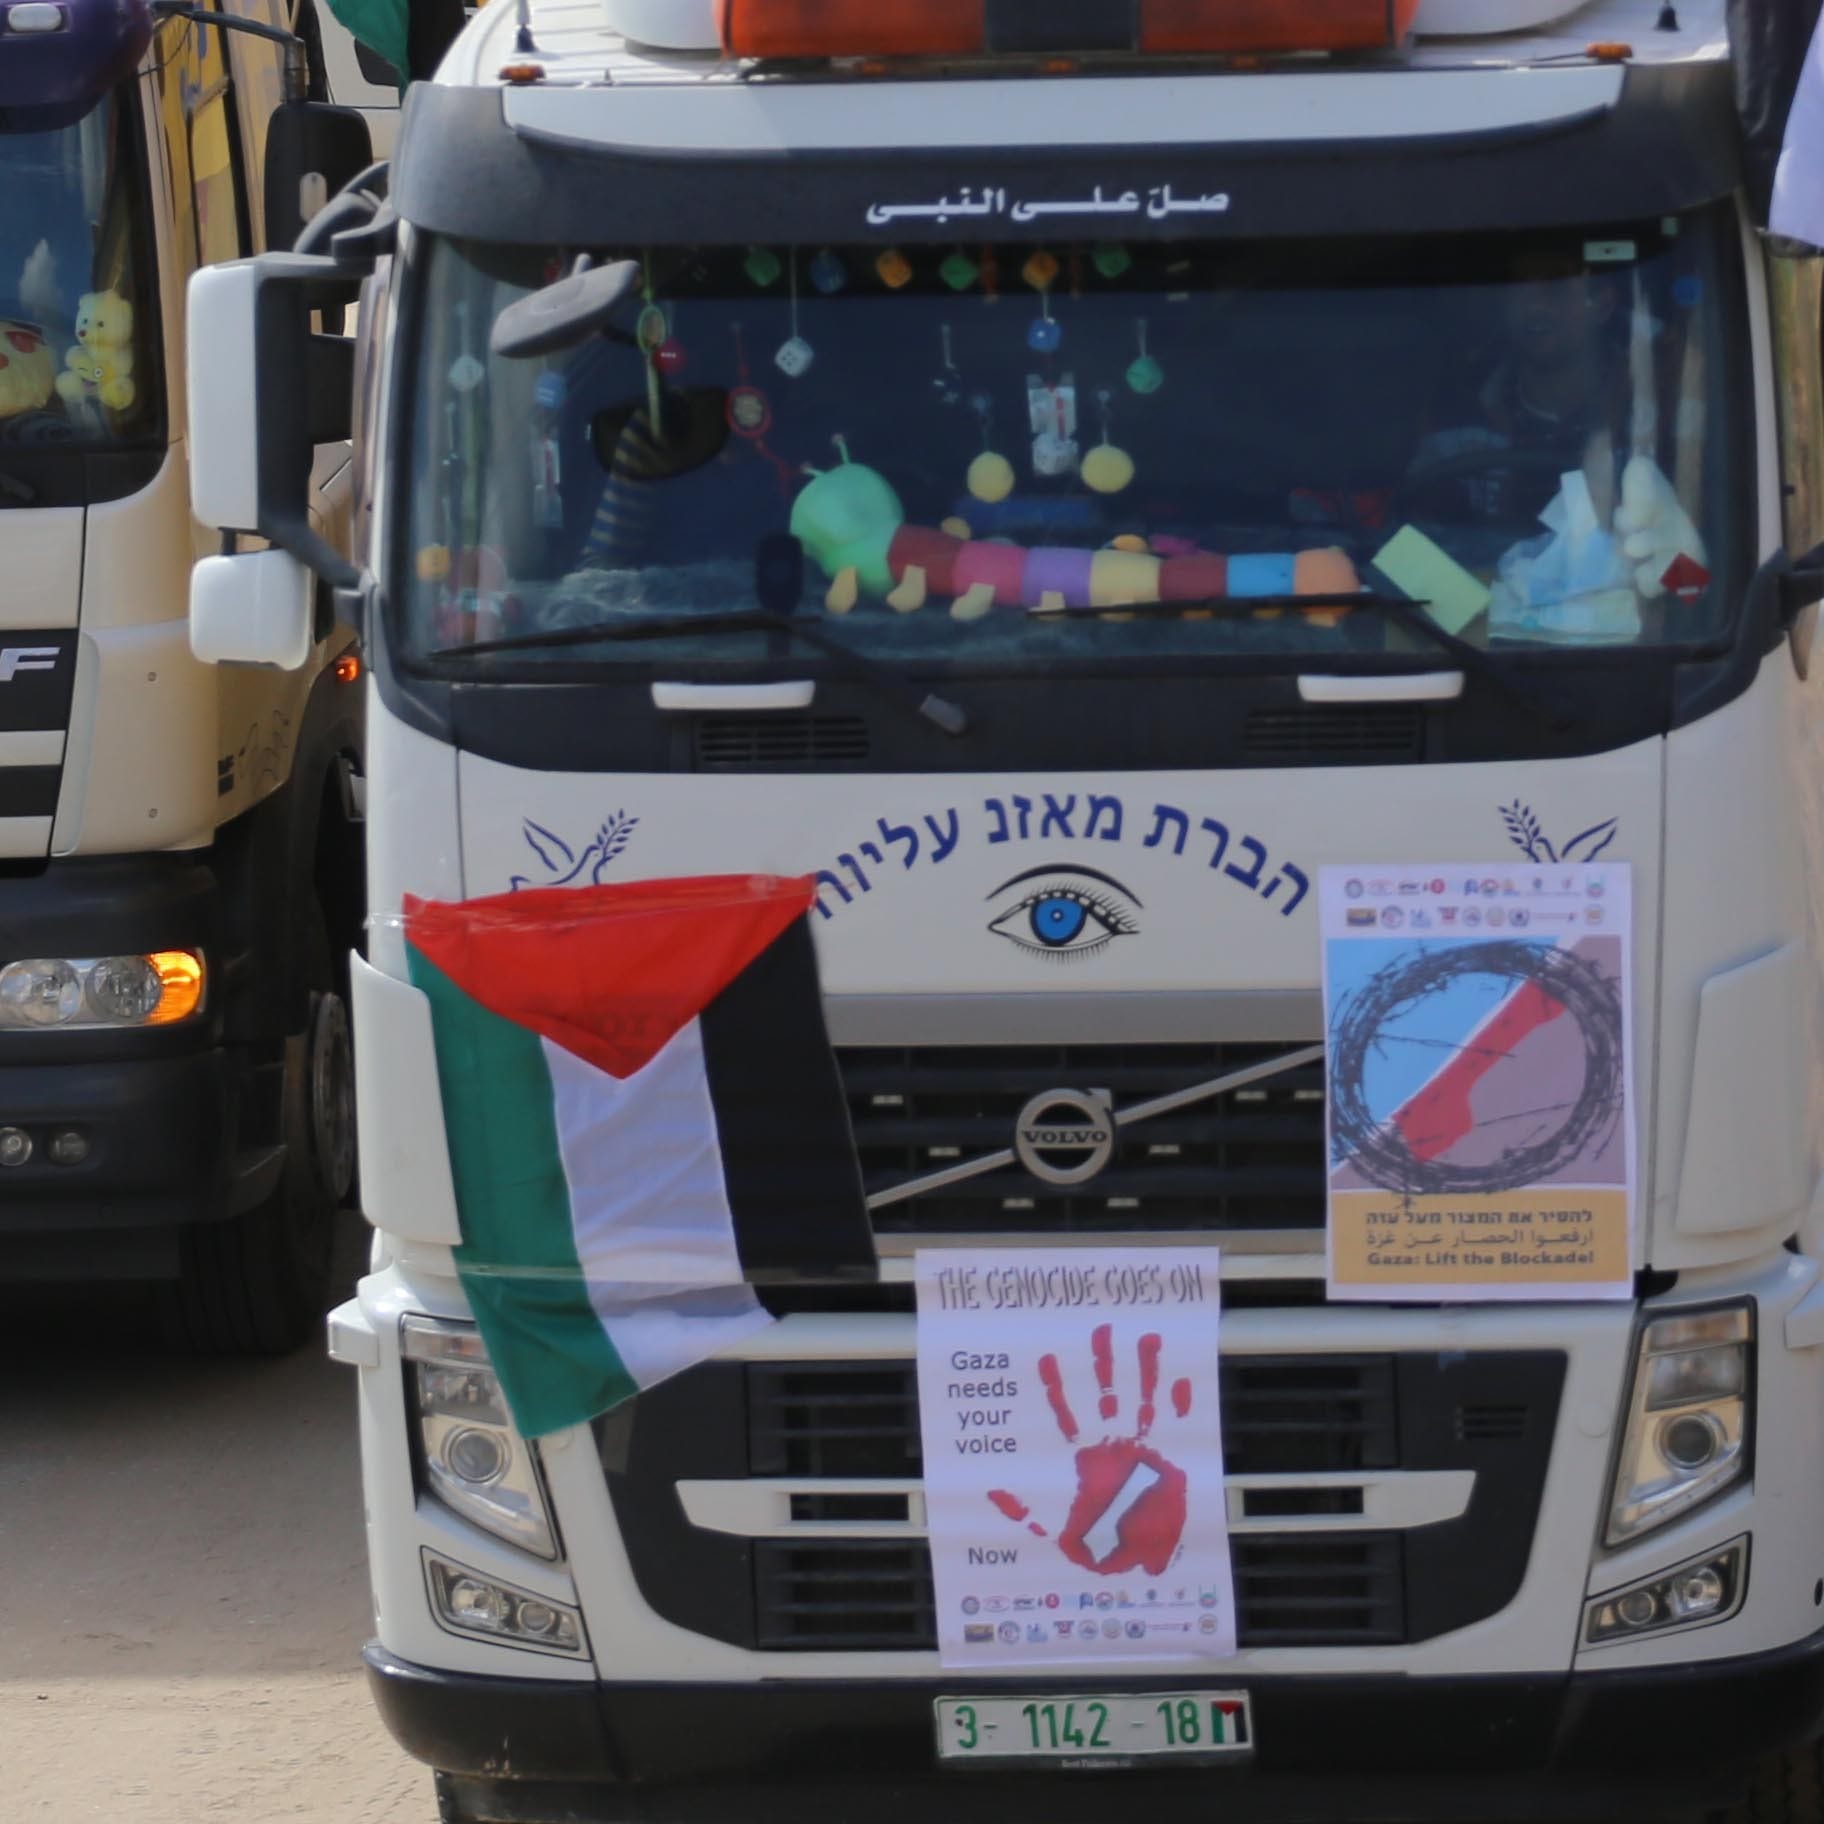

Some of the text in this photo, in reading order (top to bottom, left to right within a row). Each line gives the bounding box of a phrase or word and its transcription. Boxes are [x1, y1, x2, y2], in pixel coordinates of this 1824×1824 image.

[1022, 1130, 1107, 1144] VOLVO
[1366, 1231, 1395, 1248] غزة
[1452, 1229, 1524, 1248] الحصار
[1367, 1250, 1595, 1266] Gaza: Lift the Blockade!
[938, 1263, 1205, 1310] THE GENOCIDE GOES ON
[951, 1351, 1010, 1370] Gaza
[947, 1377, 1018, 1398] needs
[958, 1409, 1012, 1430] your
[955, 1434, 1017, 1454] voice
[968, 1547, 1018, 1565] Now
